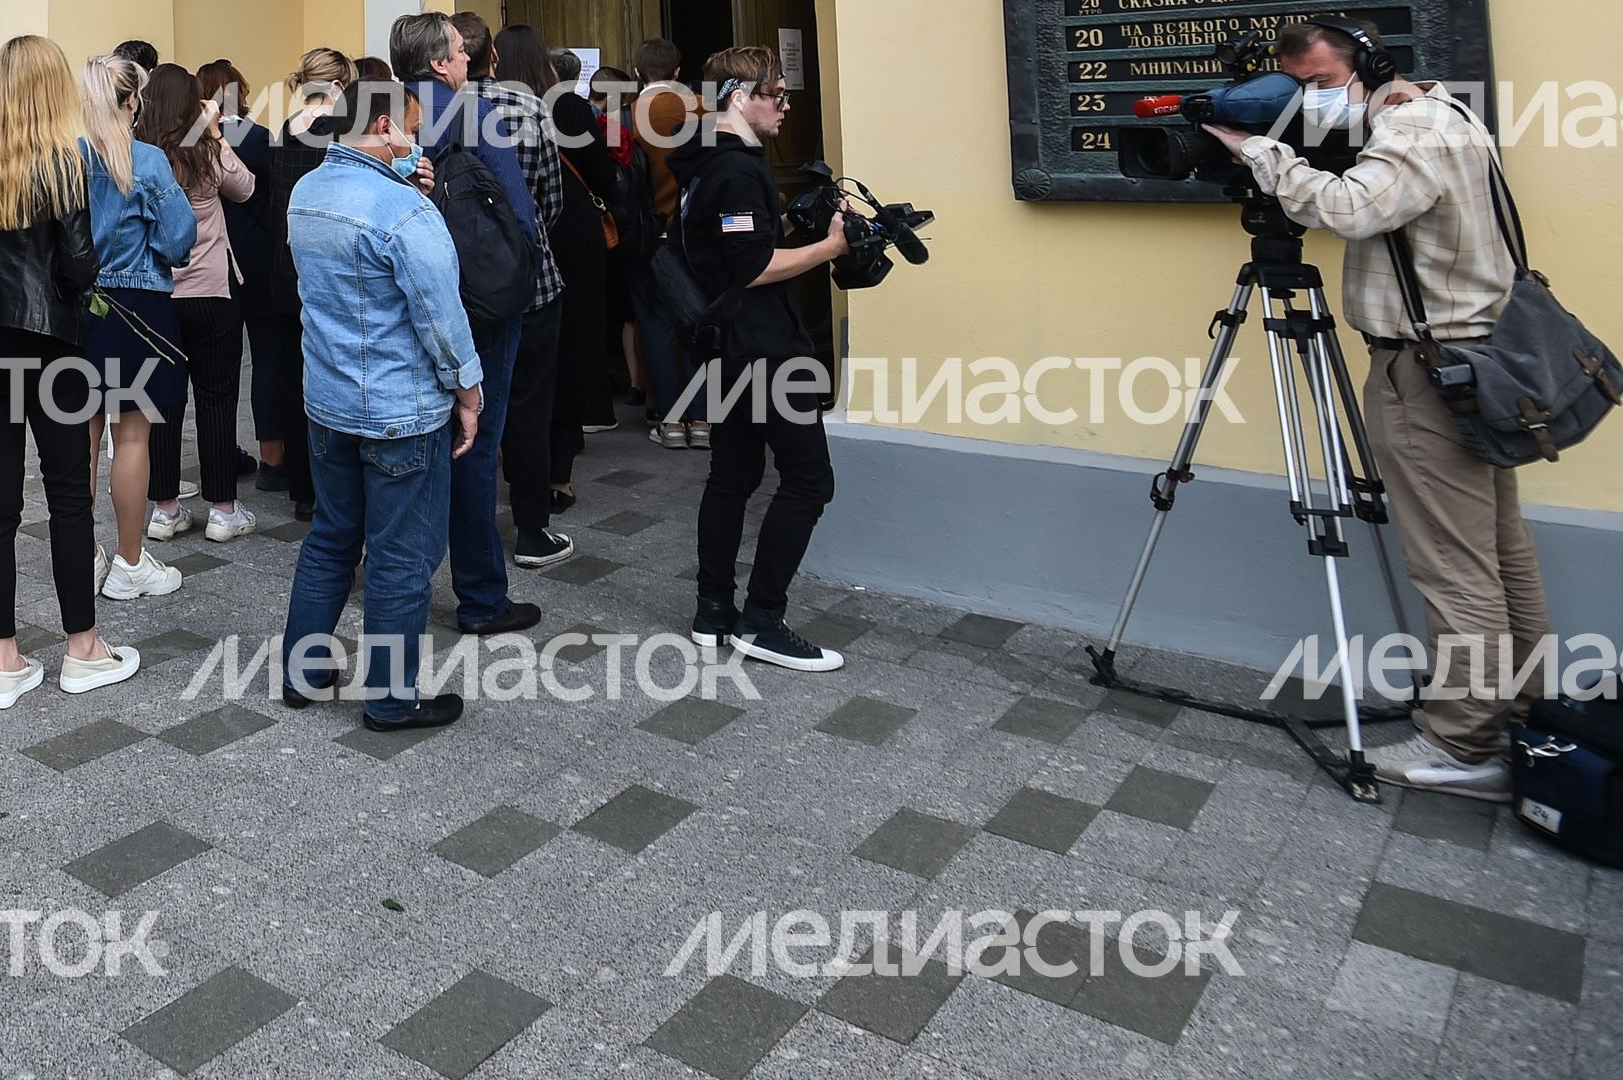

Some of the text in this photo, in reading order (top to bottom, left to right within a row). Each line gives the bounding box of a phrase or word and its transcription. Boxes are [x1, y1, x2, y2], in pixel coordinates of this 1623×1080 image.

[1075, 28, 1104, 48] 20
[1121, 24, 1143, 37] НА
[1153, 18, 1240, 35] ВСЯКОГО
[1250, 12, 1346, 30] МУДР
[1128, 31, 1227, 48] ДОВОЛЬНО
[1079, 59, 1223, 80] 22 МНИМЫЙ
[1077, 94, 1106, 111] 23
[1081, 132, 1112, 149] 24
